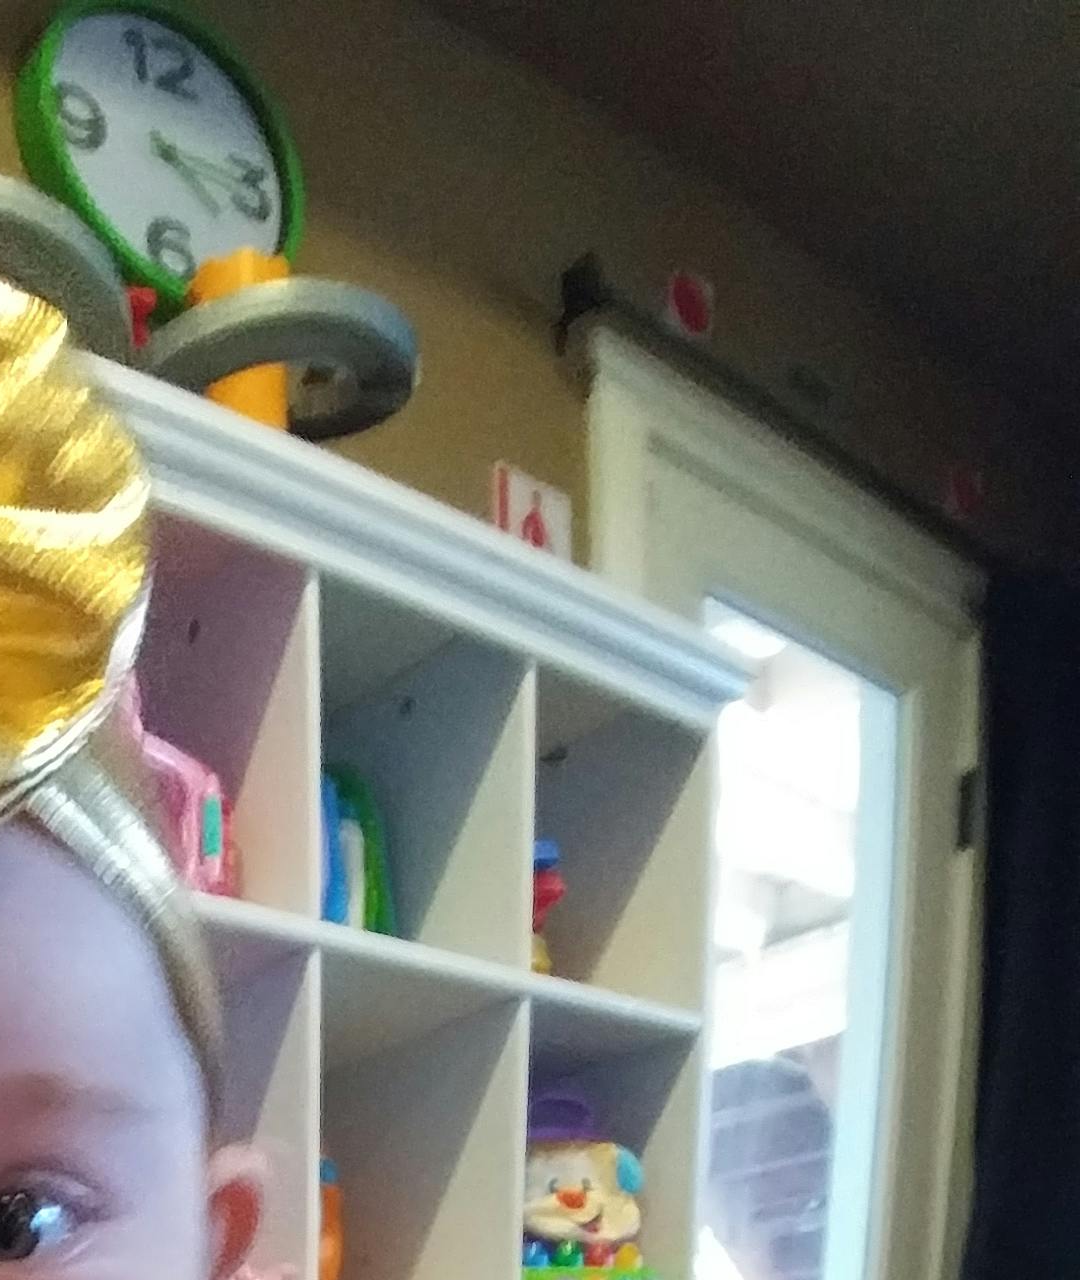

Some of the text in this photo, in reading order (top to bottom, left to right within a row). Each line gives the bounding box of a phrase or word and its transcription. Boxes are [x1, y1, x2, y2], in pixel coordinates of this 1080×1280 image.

[124, 26, 200, 103] 12
[55, 80, 108, 151] 9
[228, 152, 272, 223] 3
[145, 215, 196, 281] 6
